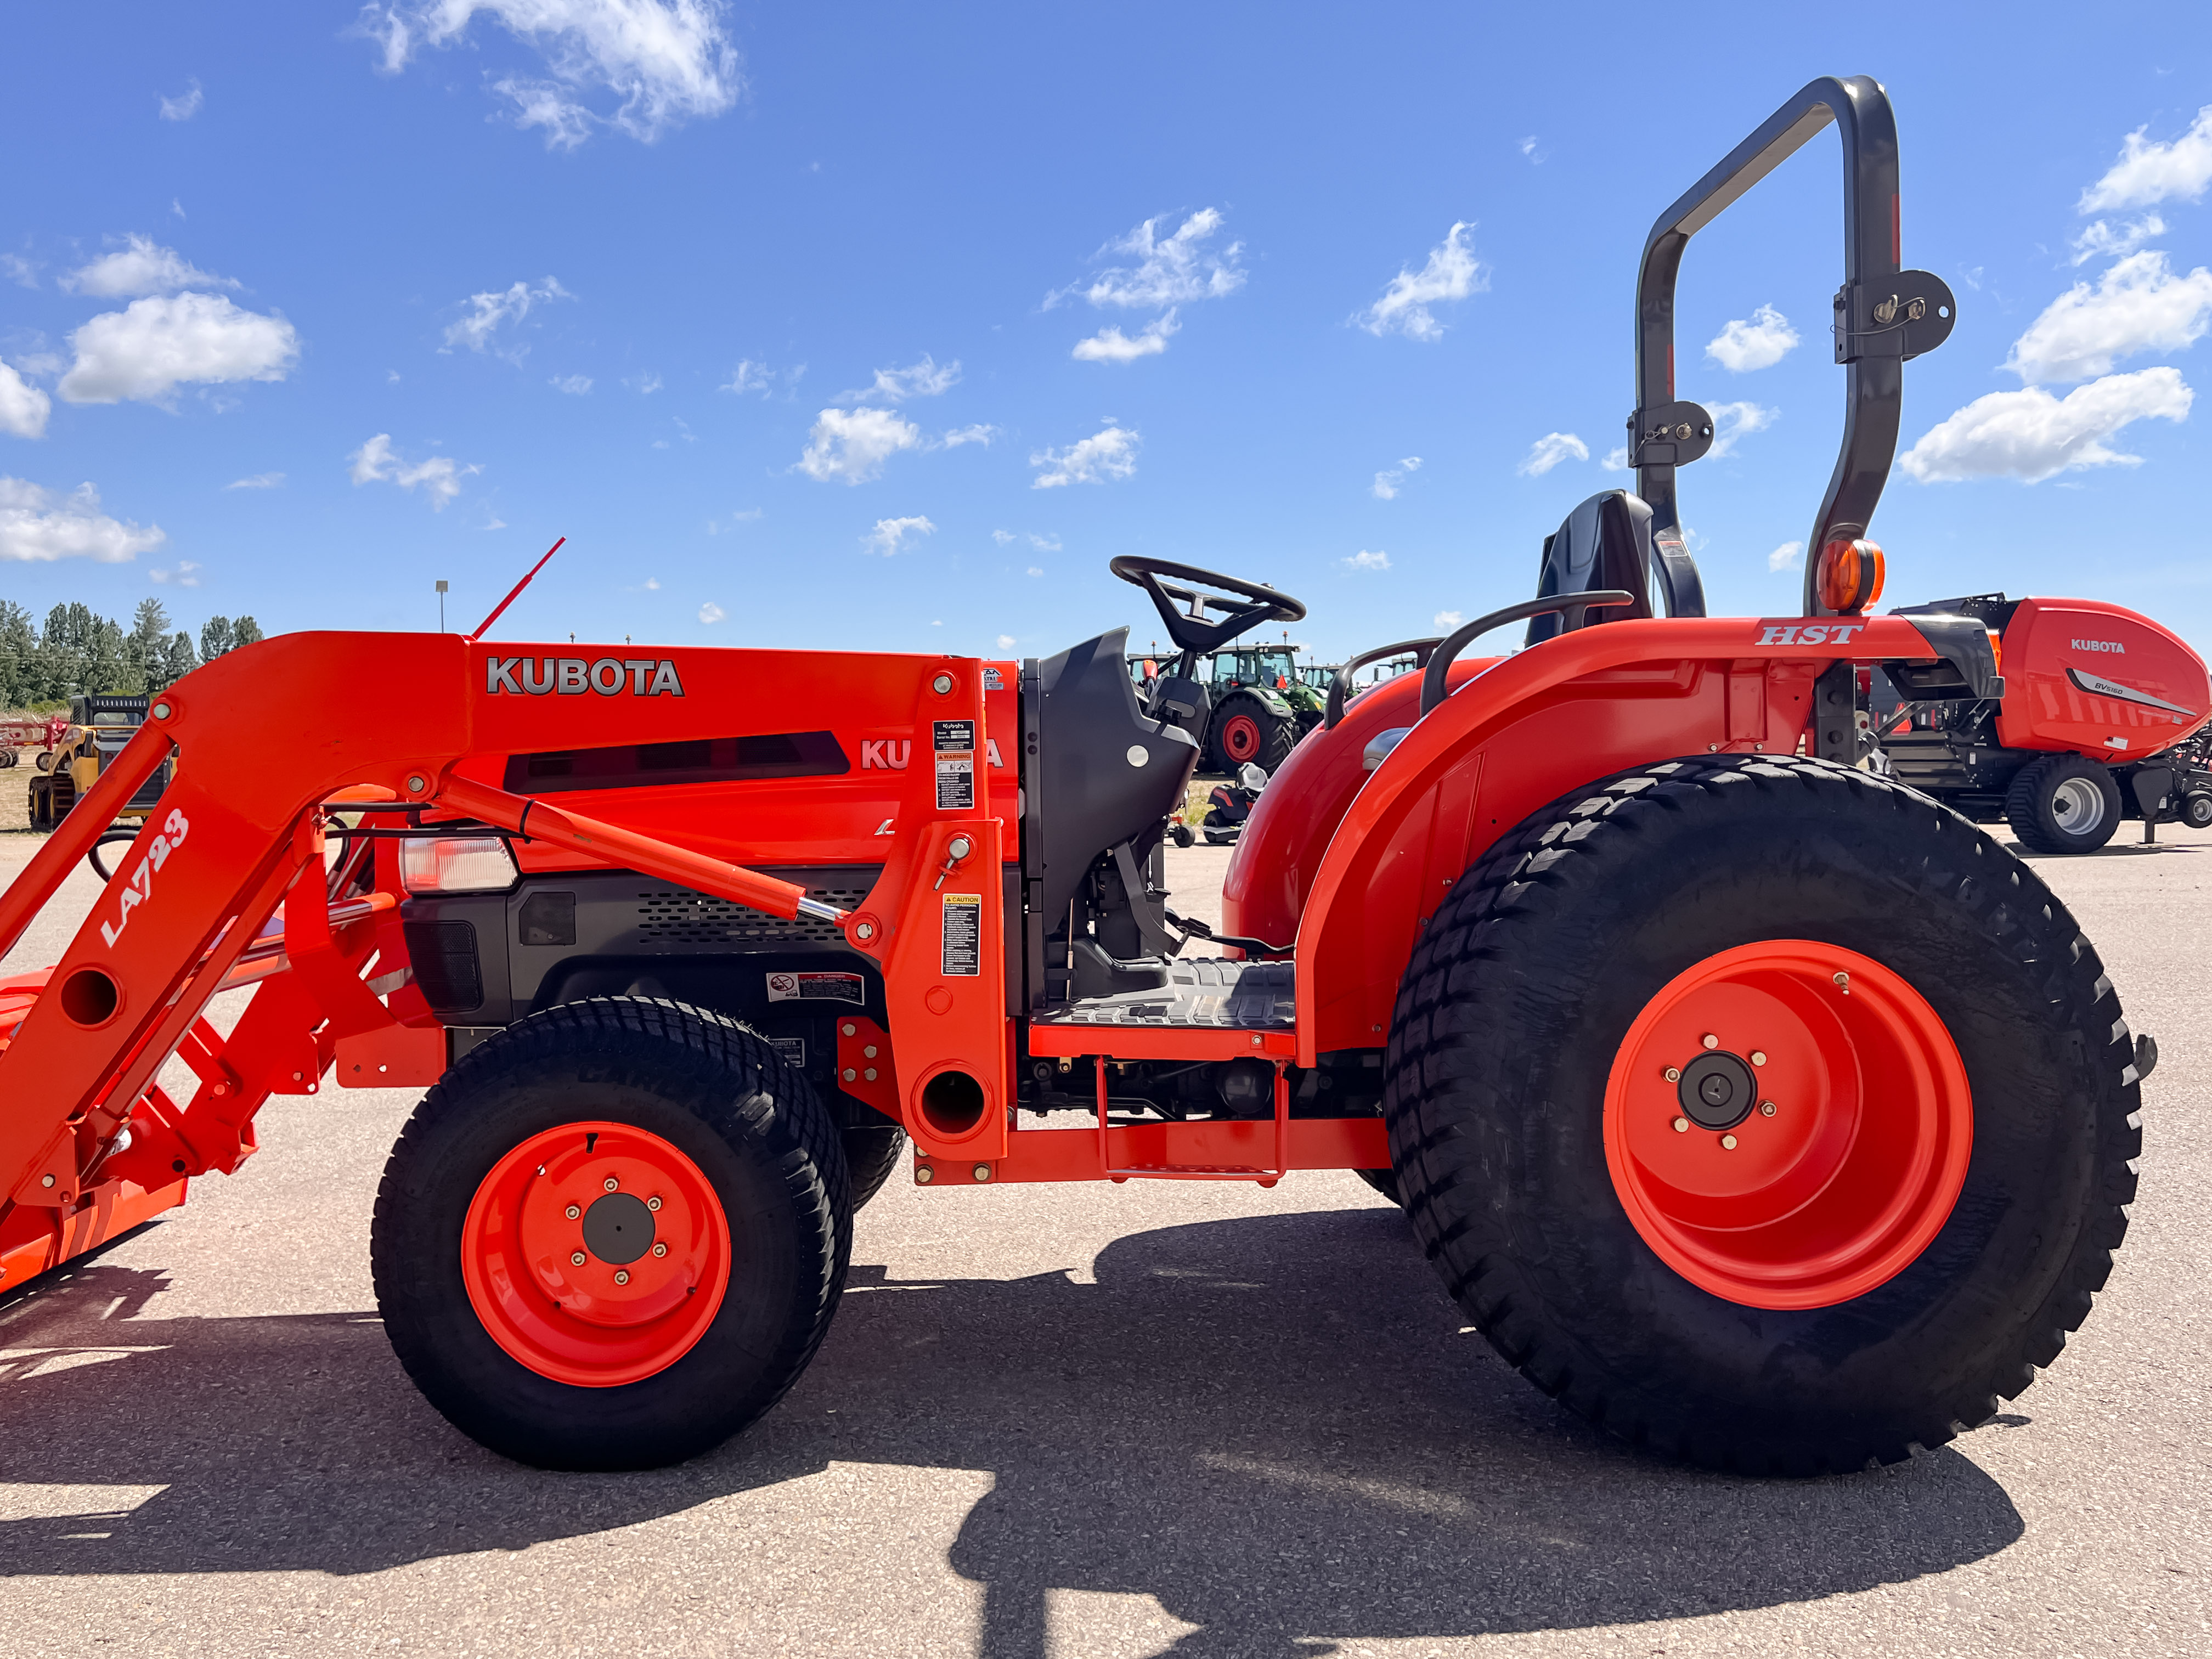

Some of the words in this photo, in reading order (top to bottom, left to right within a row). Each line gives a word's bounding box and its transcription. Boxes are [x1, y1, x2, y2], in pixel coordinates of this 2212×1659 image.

[1754, 625, 1864, 646] HST
[2071, 639, 2125, 654] KUBOTA
[487, 657, 685, 697] KUBOTA
[100, 808, 189, 949] LA723
